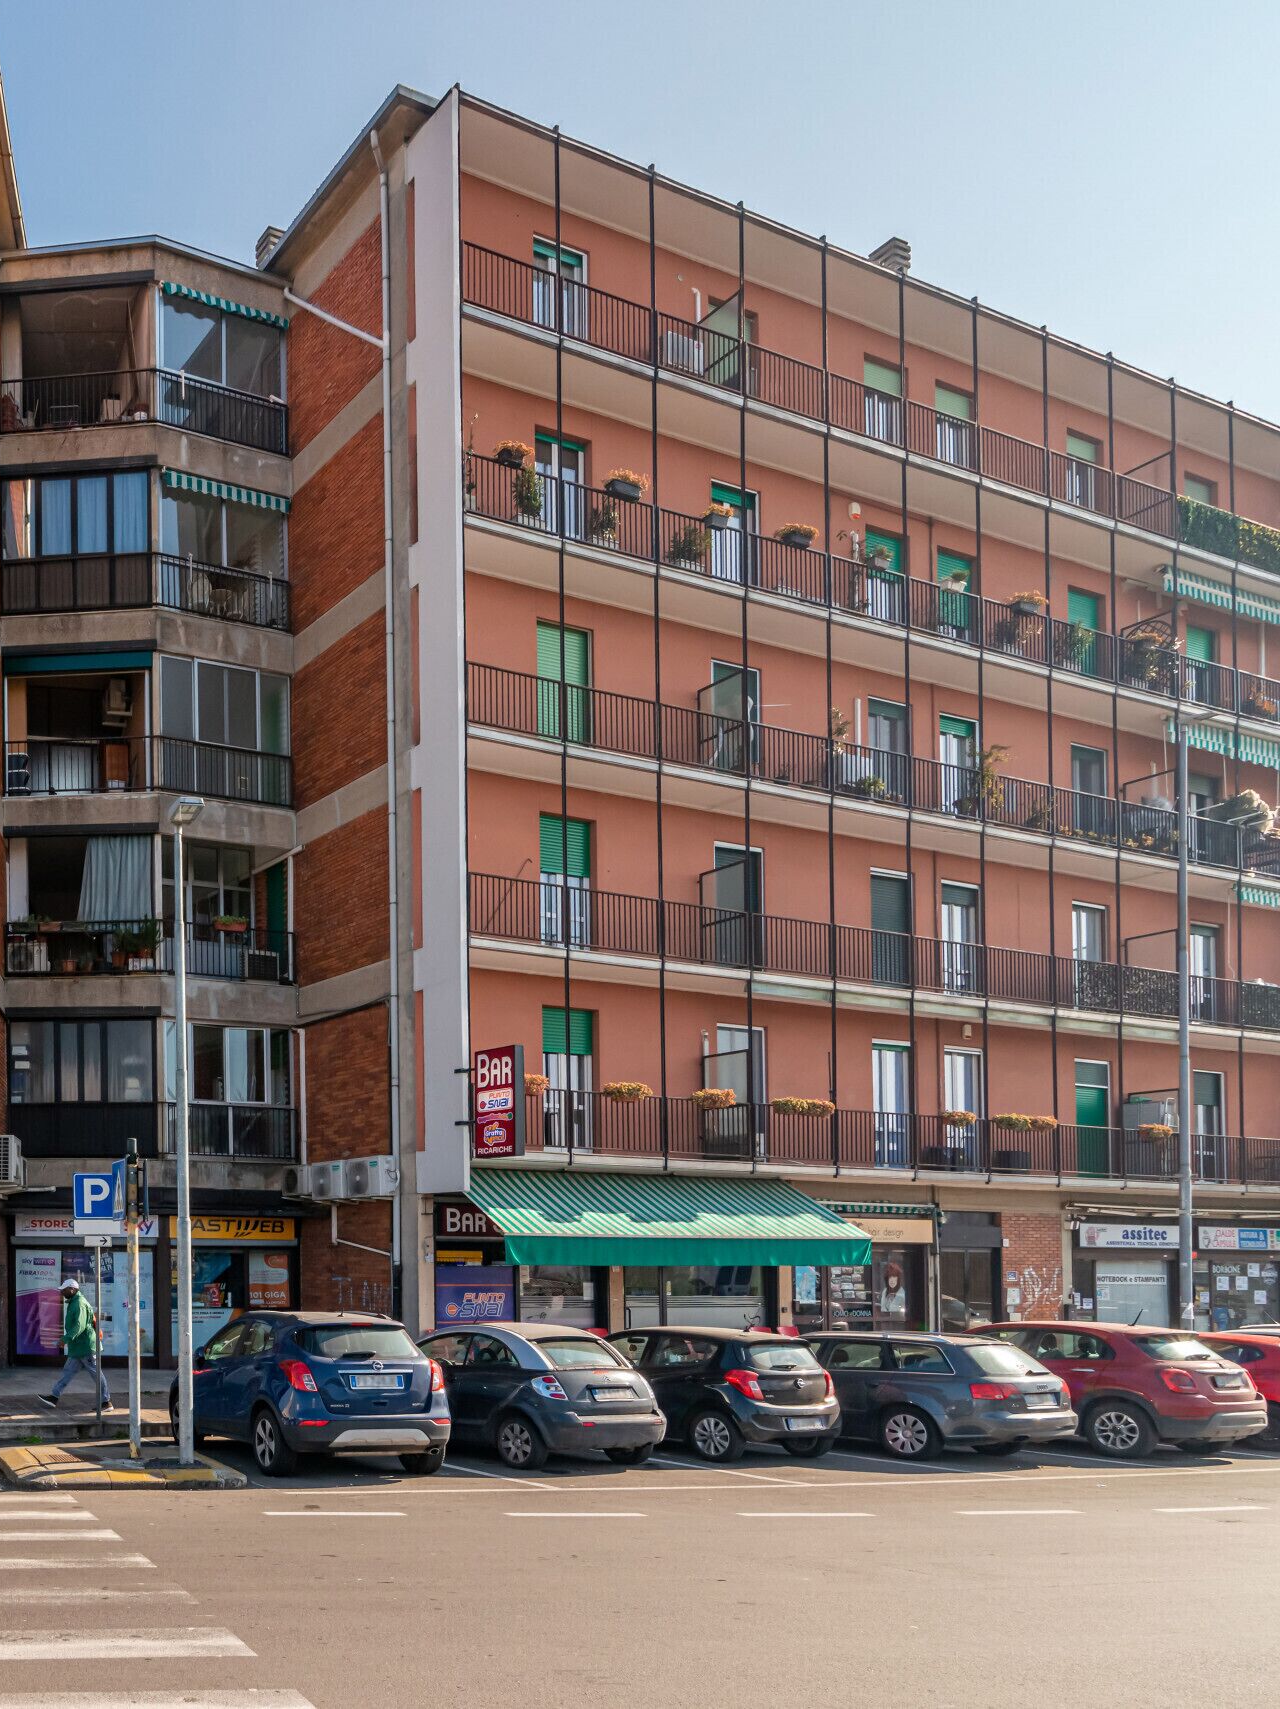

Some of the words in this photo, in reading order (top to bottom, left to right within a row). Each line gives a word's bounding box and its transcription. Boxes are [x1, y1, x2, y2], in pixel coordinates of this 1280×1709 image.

[477, 1053, 512, 1088] BAR
[477, 1146, 513, 1155] RICARICHE
[83, 1178, 110, 1214] P
[446, 1208, 486, 1233] BAR
[191, 1219, 285, 1237] ASTWEB
[884, 1227, 904, 1239] design
[1122, 1227, 1168, 1241] assitec
[1097, 1275, 1128, 1283] NOTEBOOK
[249, 1291, 263, 1299] 101
[264, 1291, 287, 1299] GIGA
[463, 1292, 505, 1303] PUNTO
